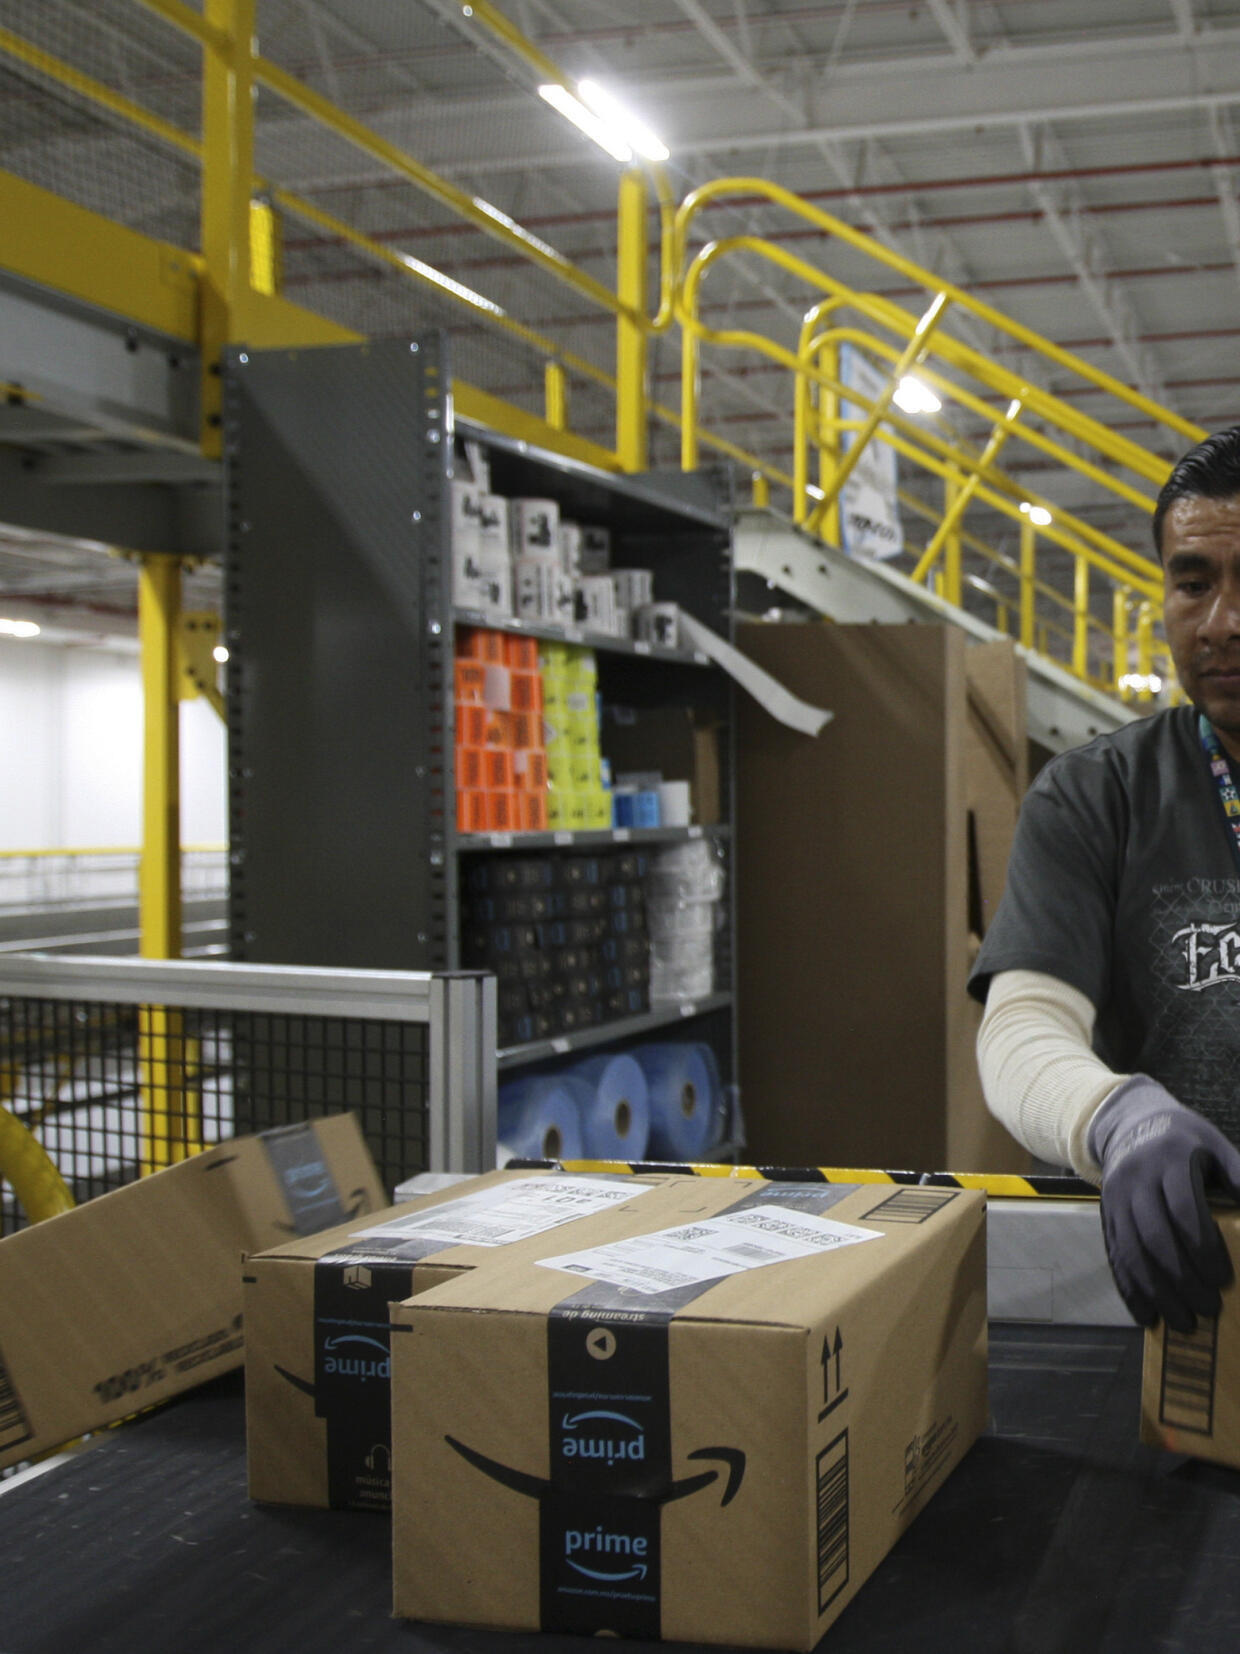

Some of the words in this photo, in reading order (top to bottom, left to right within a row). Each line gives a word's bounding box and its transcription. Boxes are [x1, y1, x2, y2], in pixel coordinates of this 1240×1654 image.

[580, 1309, 645, 1323] streaming
[562, 1434, 645, 1466] prime
[565, 1525, 648, 1556] prime
